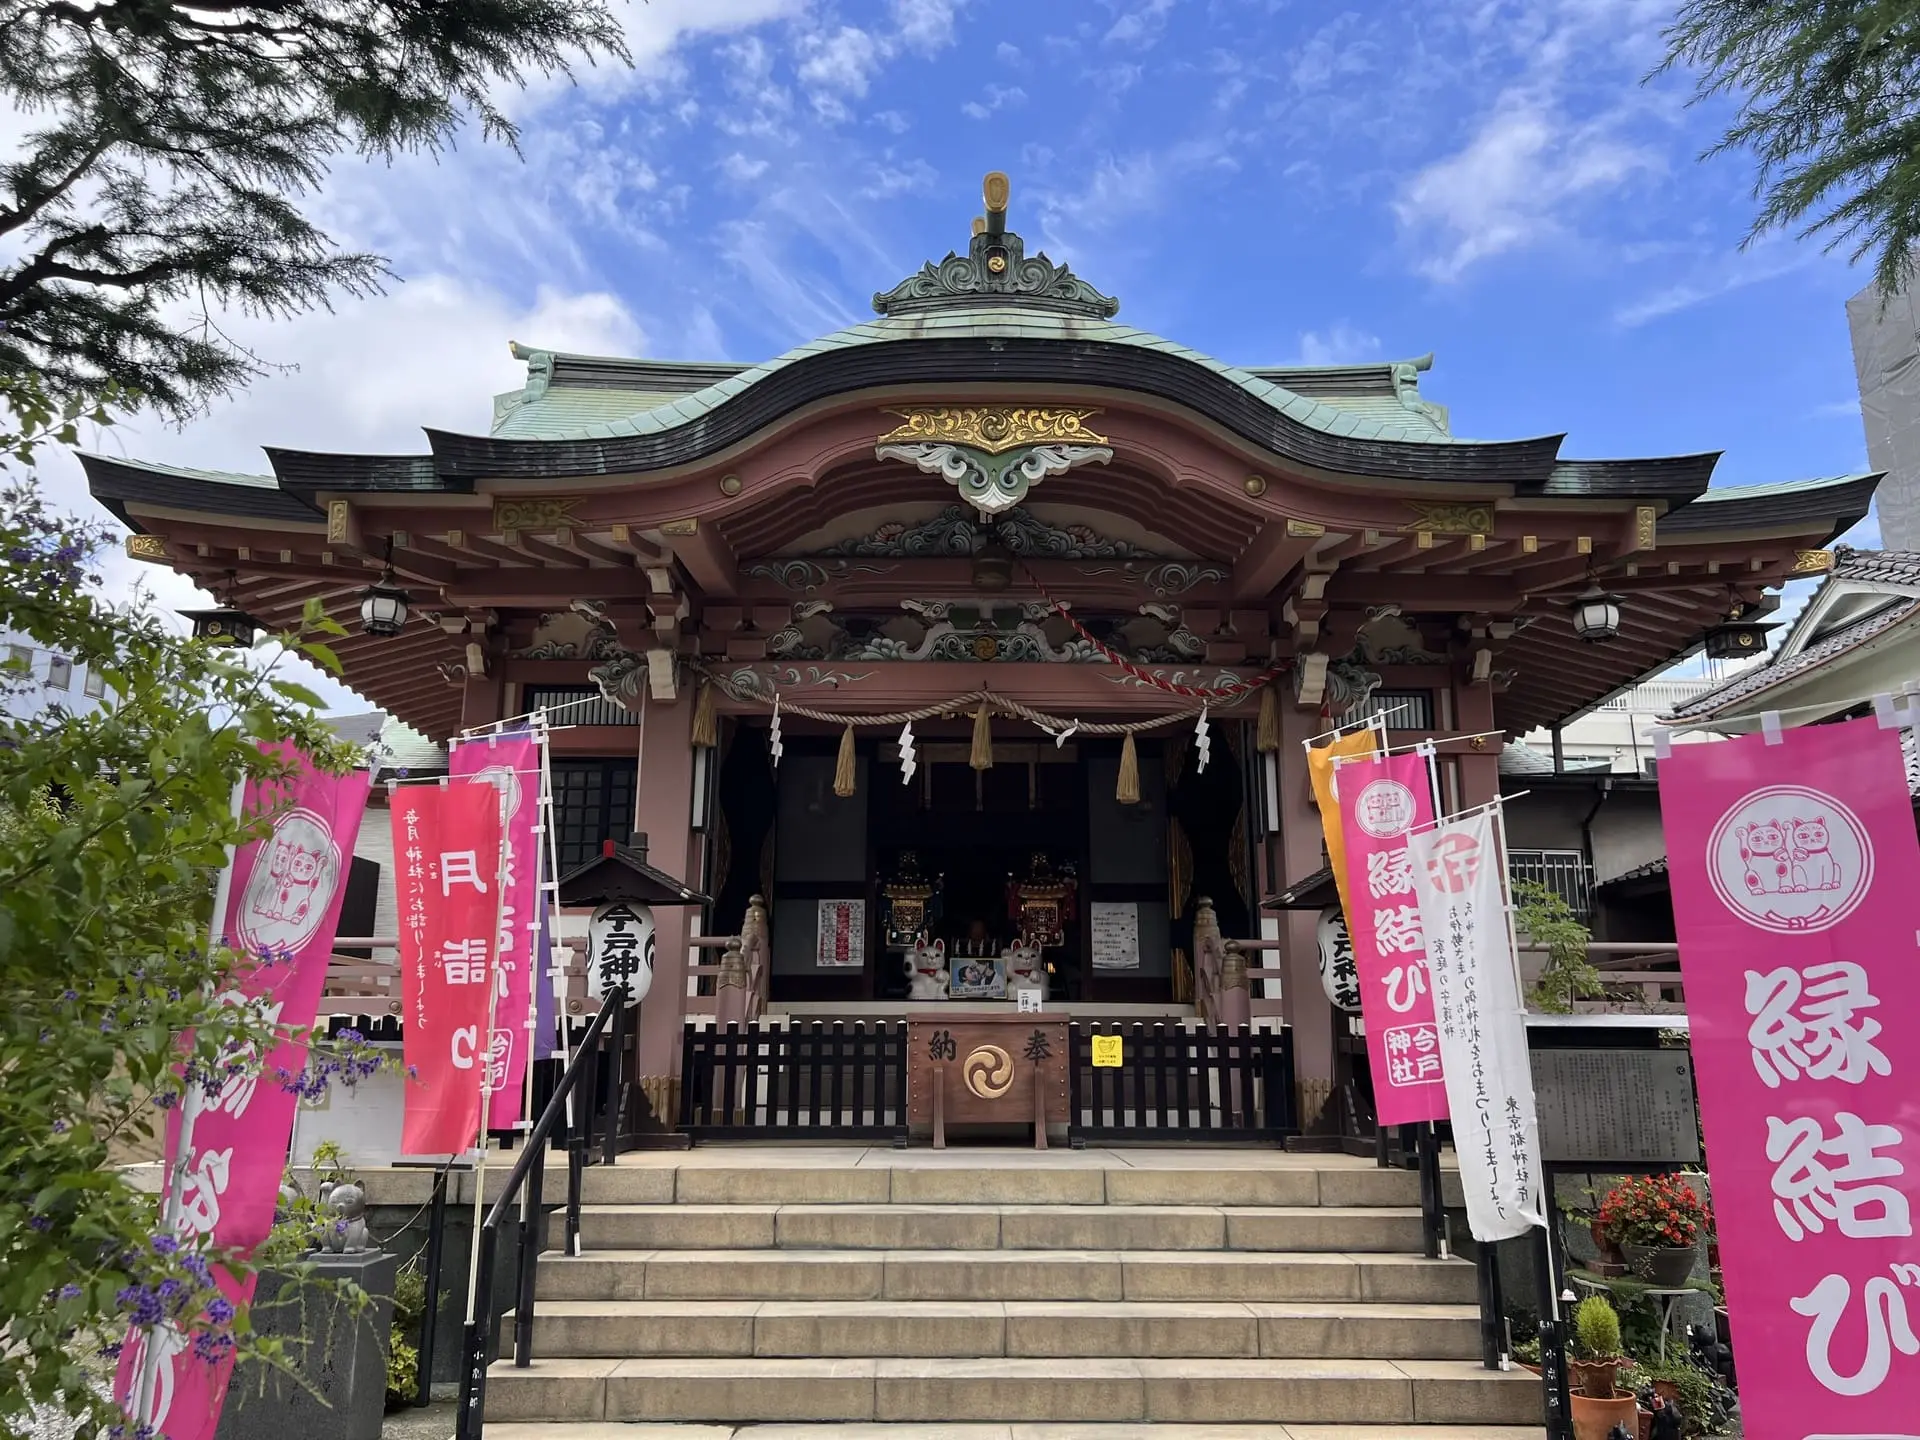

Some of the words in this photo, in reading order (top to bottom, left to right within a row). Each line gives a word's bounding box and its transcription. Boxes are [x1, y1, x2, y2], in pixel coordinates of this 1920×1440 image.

[1366, 850, 1430, 1013] 縁結び
[928, 1030, 958, 1062] 納
[1024, 1028, 1053, 1067] 奉
[1387, 1030, 1417, 1083] 神社
[1412, 1027, 1441, 1078] 今戸
[1744, 960, 1920, 1398] 縁結び
